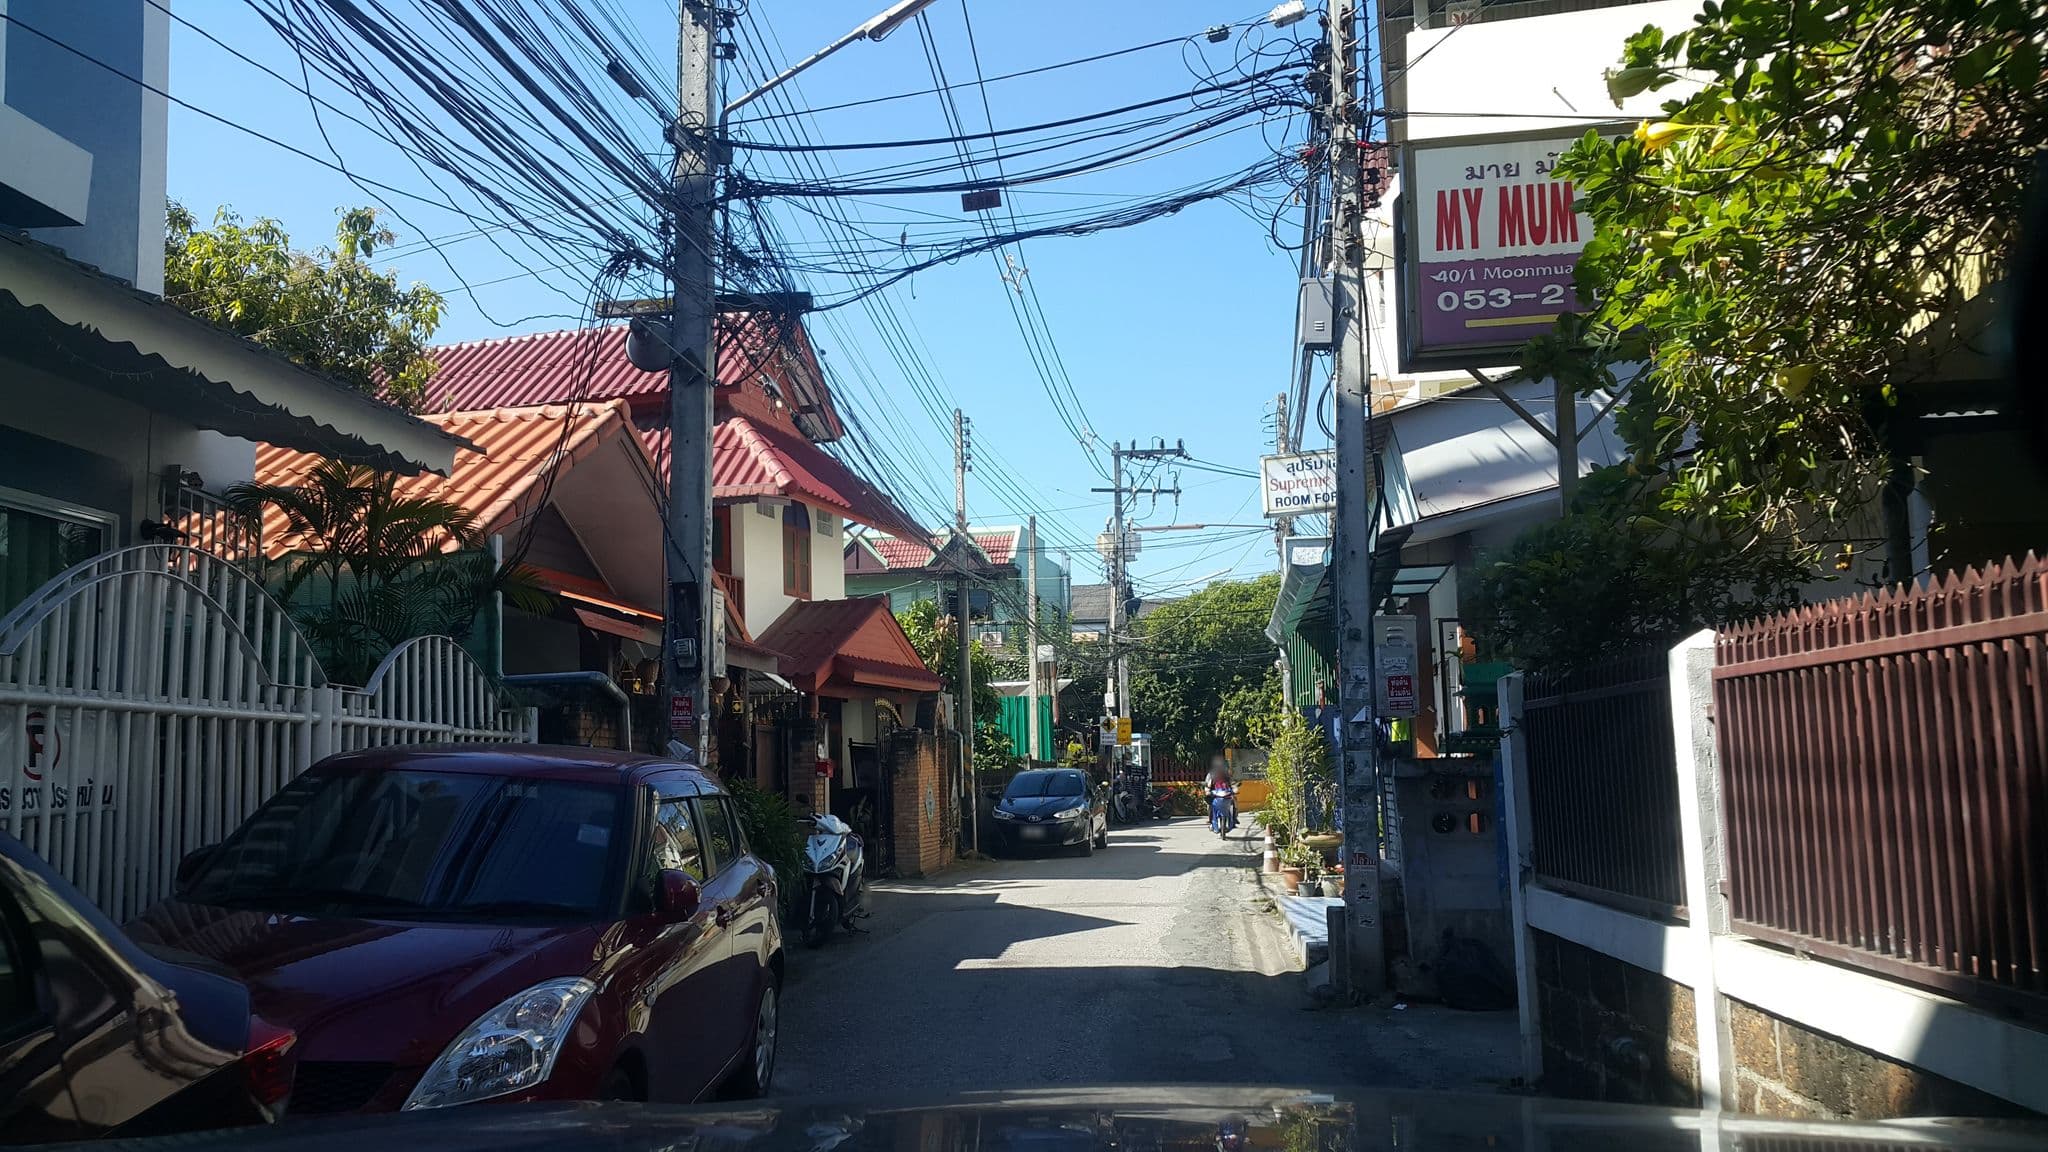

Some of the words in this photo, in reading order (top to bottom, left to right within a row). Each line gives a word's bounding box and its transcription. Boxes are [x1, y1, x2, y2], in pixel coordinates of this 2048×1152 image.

[1465, 162, 1520, 181] มาย
[1435, 188, 1484, 252] MY
[1498, 181, 1579, 248] MUM
[1483, 264, 1574, 280] Moonmua
[1437, 284, 1577, 312] 053-2
[1270, 476, 1330, 494] Supreme
[1275, 495, 1311, 508] ROOM
